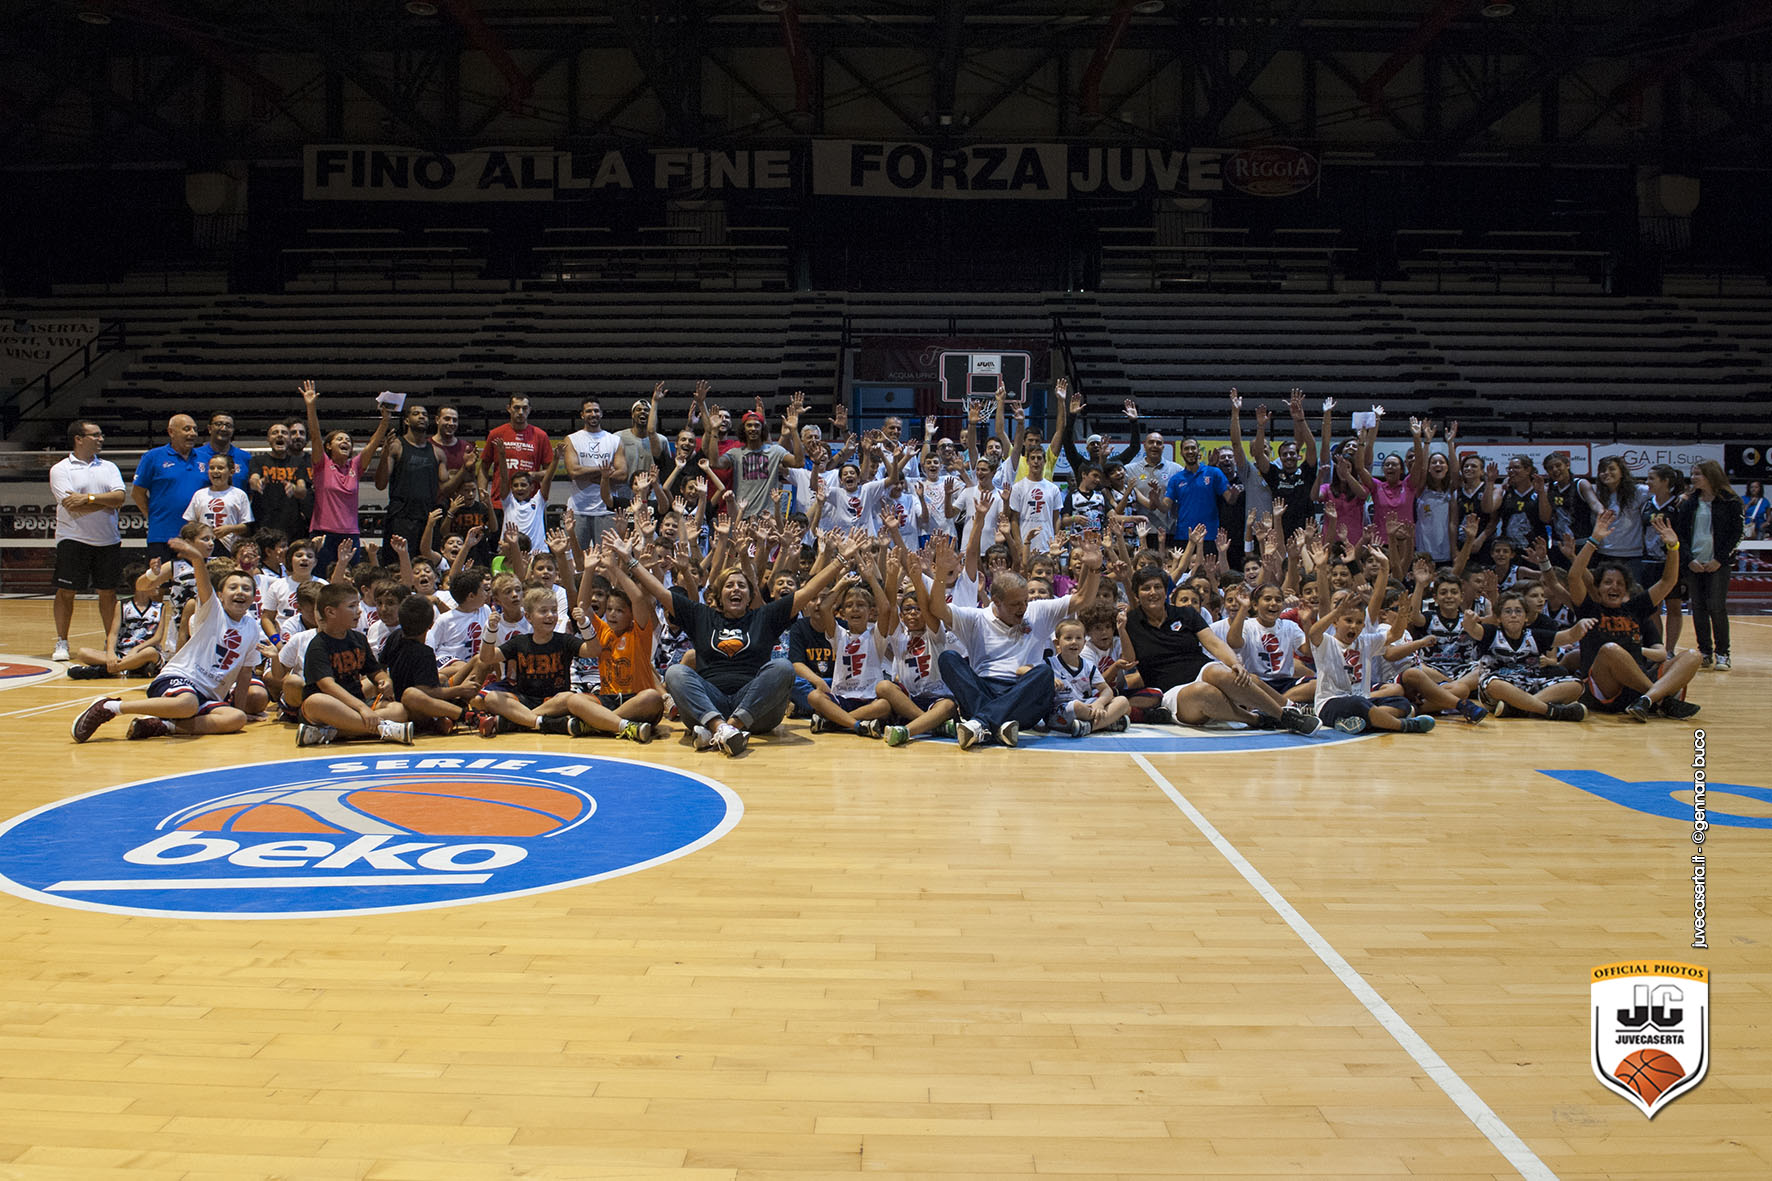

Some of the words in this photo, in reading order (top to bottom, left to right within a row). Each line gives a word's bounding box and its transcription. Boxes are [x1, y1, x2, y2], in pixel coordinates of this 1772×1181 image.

[316, 150, 456, 189] FINO
[478, 150, 634, 189] ALLA
[653, 150, 792, 189] FINE
[850, 144, 1050, 190] FORZA
[1070, 147, 1224, 193] JUVE
[1235, 156, 1310, 177] REGGIA
[6, 347, 50, 359] VINCI
[579, 452, 611, 460] GIVOVA
[328, 758, 538, 773] SERIE
[536, 764, 593, 777] A
[122, 830, 529, 871] beko
